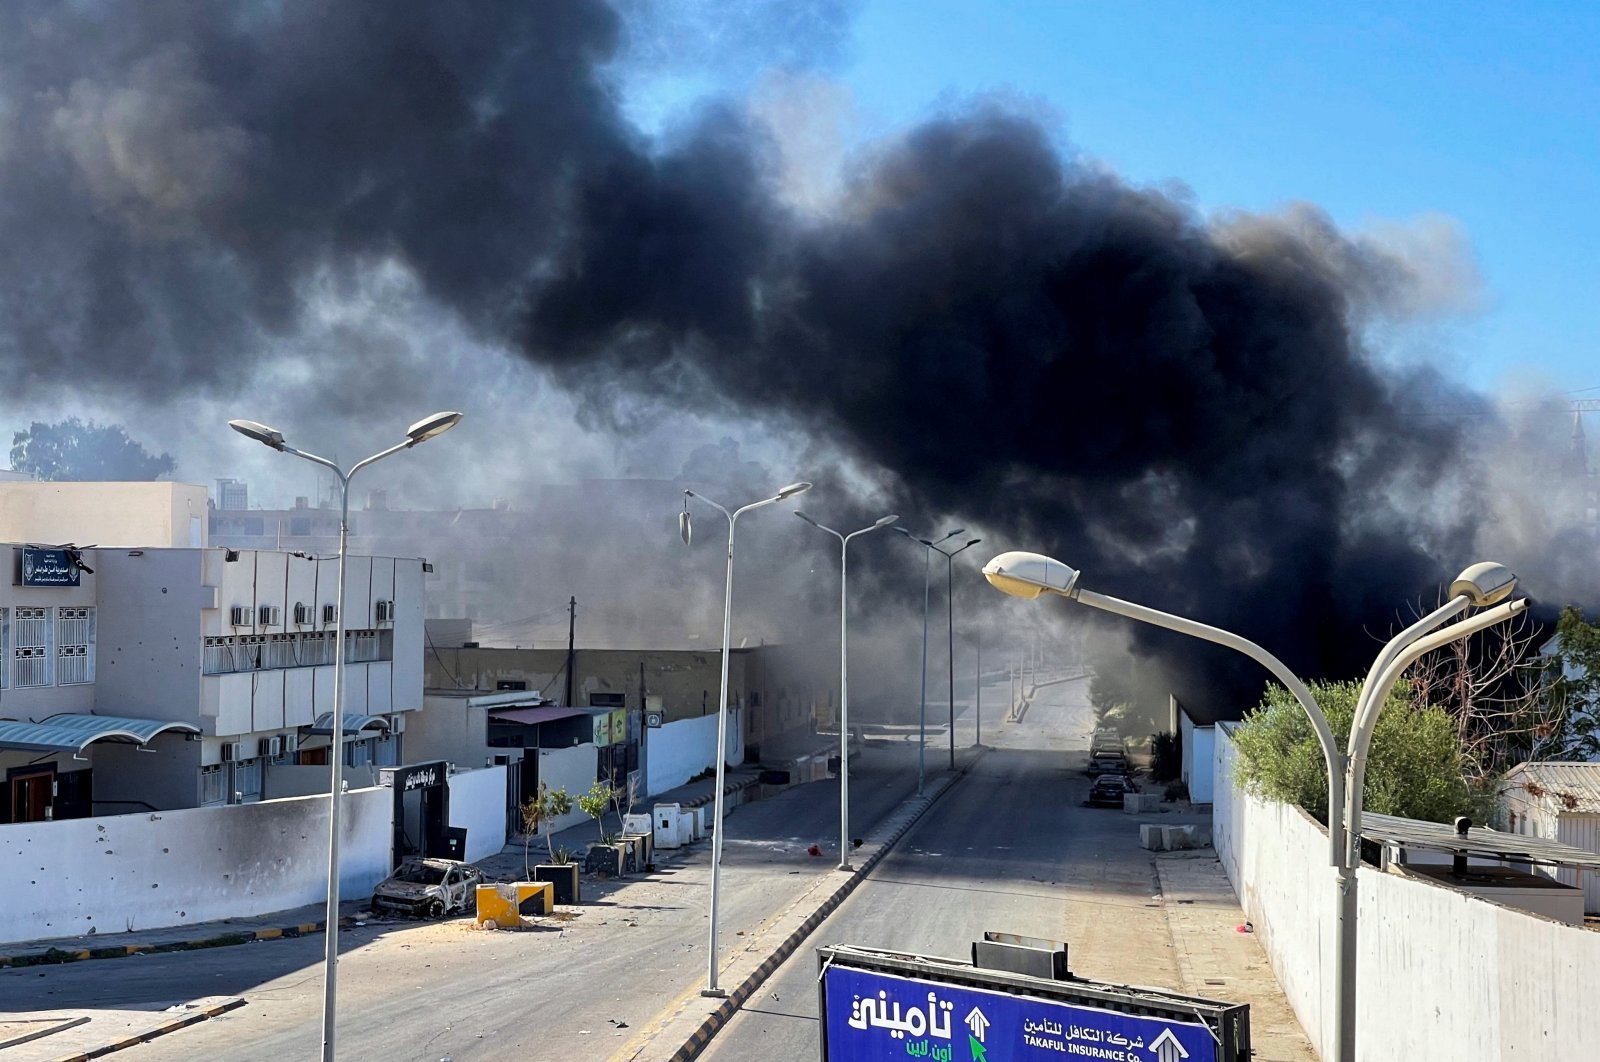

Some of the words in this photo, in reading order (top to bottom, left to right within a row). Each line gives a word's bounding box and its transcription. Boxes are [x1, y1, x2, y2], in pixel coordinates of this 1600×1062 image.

[55, 566, 69, 575] مديرية
[848, 990, 954, 1039] تأميني
[1024, 1017, 1062, 1035] للتأمين
[1065, 1025, 1104, 1042] التكافل
[906, 1039, 929, 1058] لاين
[1024, 1034, 1066, 1052] TAKAFUL
[1068, 1043, 1125, 1062] INSURANCE
[1106, 1031, 1144, 1050] شركة
[931, 1043, 952, 1062] أون
